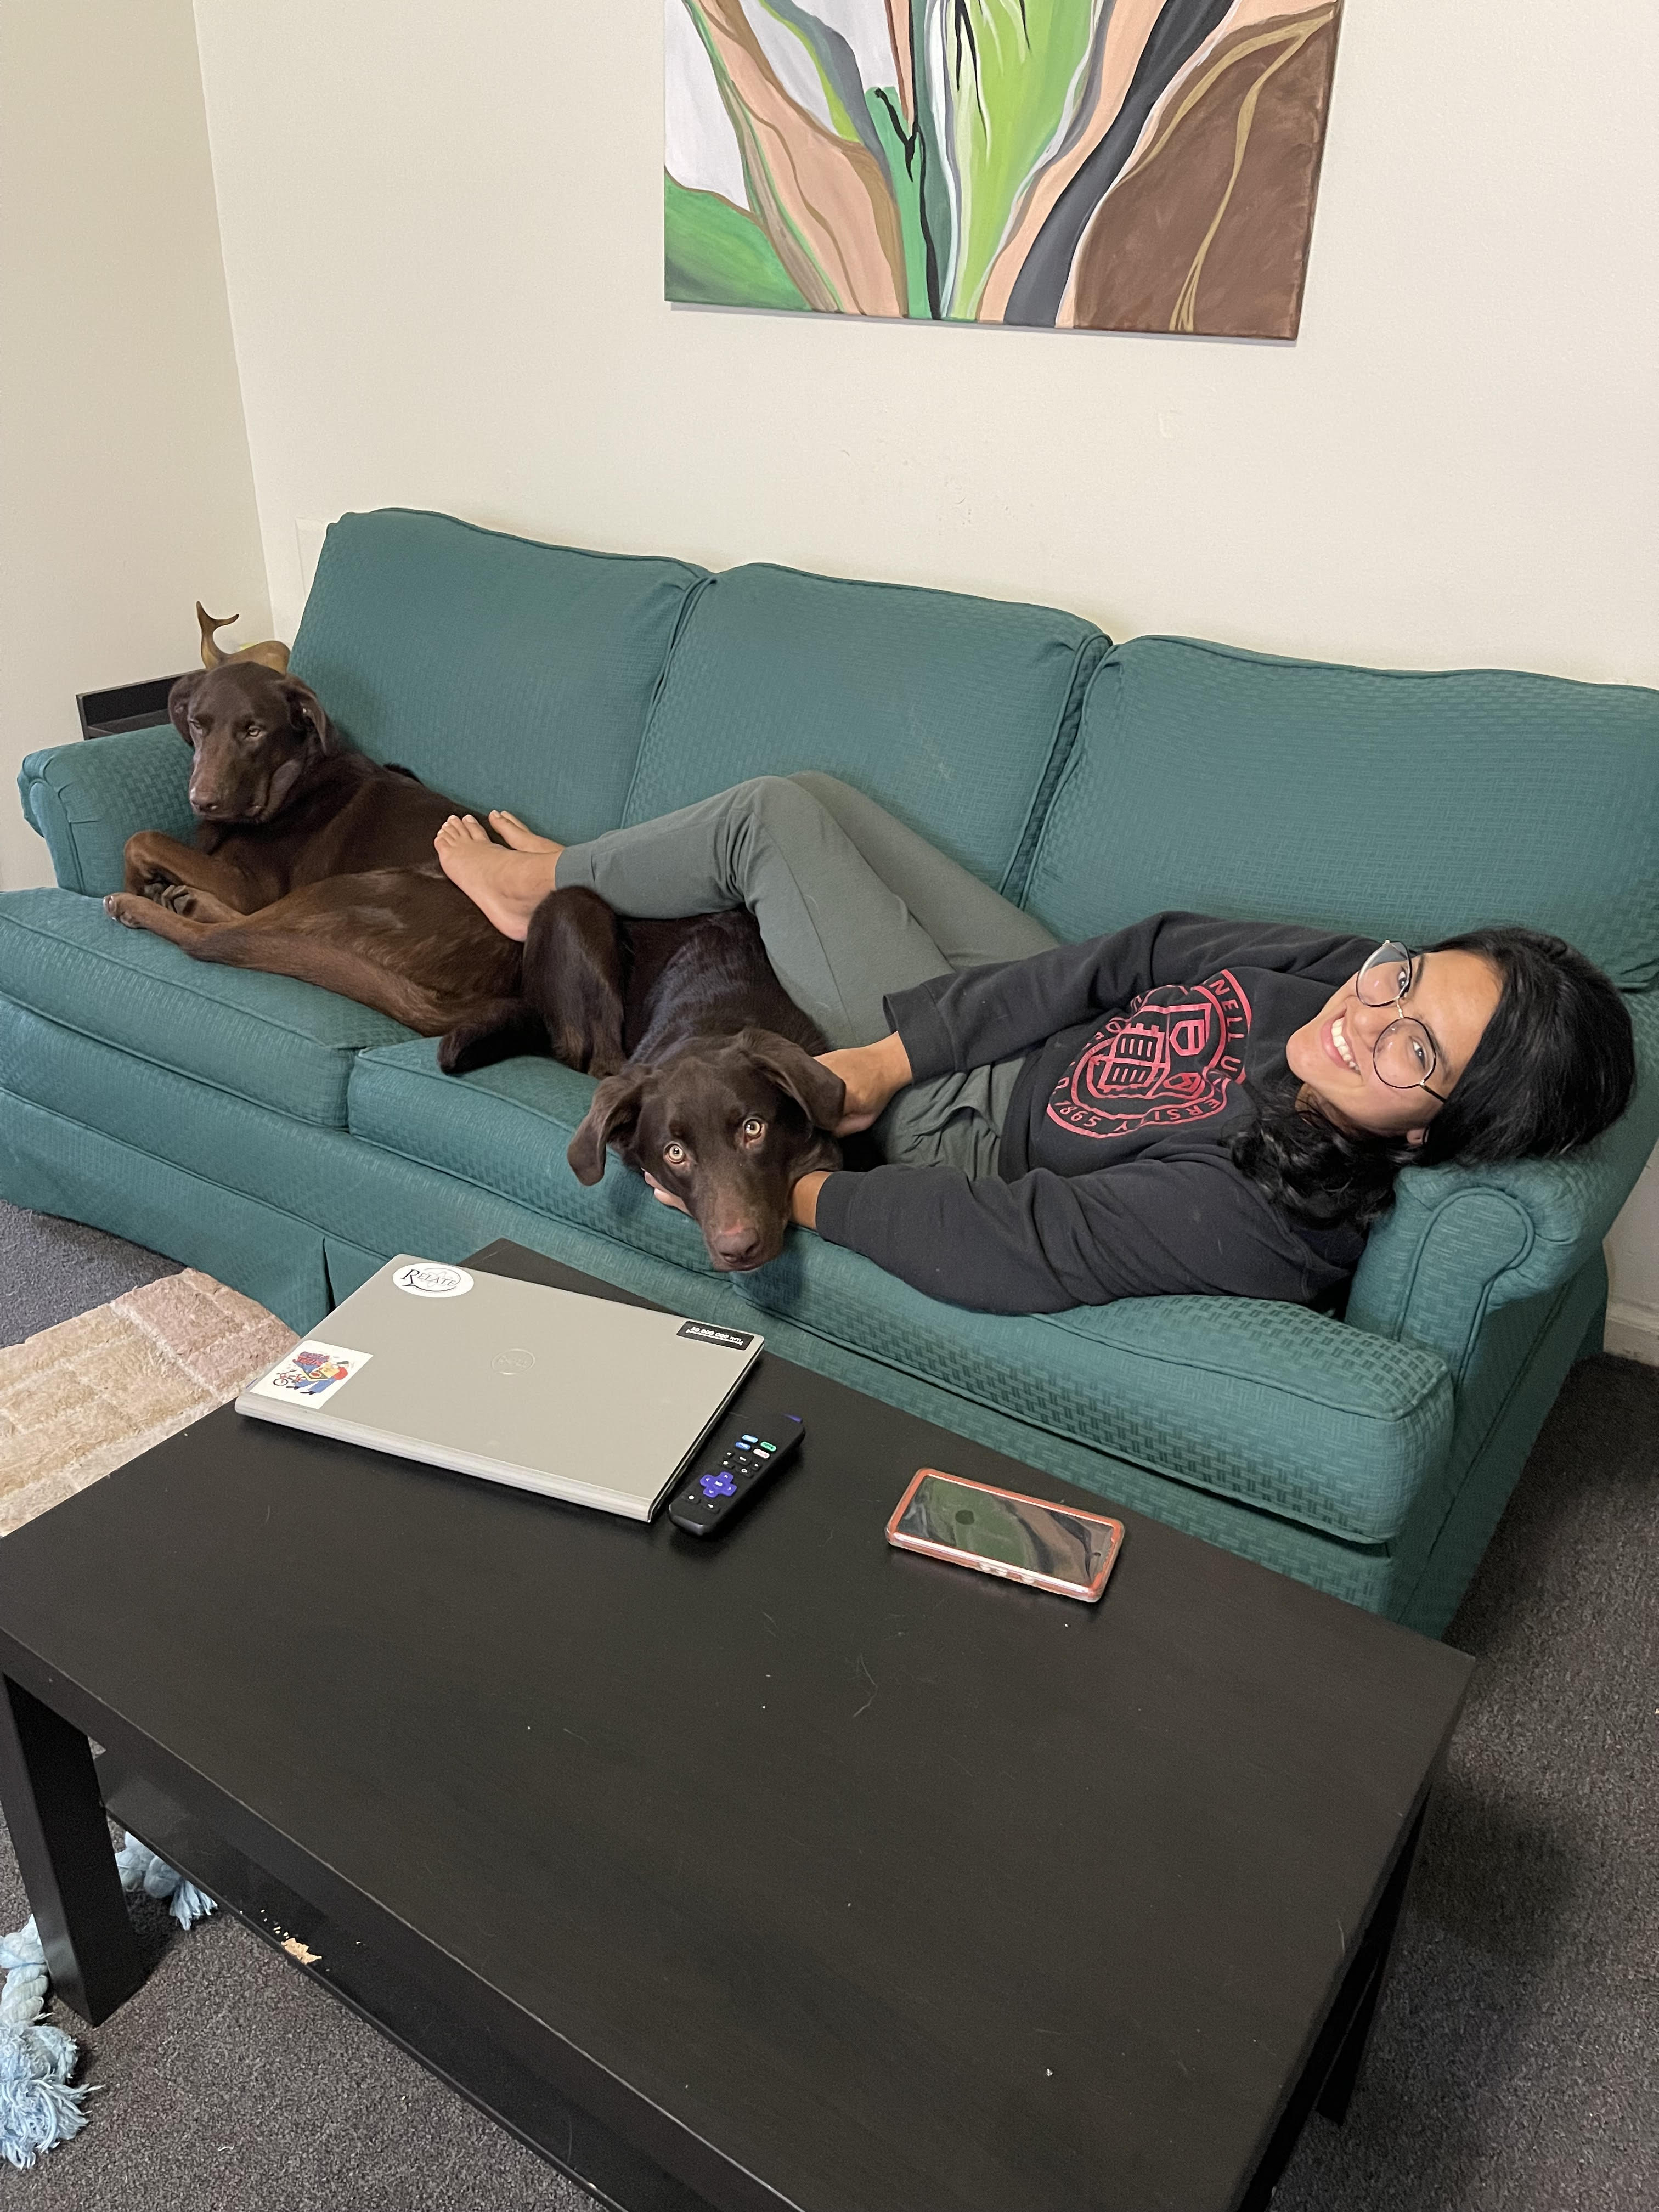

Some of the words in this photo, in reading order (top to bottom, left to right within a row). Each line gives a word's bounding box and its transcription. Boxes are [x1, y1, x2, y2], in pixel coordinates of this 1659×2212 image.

[1209, 978, 1245, 1043] NELL
[1054, 1100, 1102, 1127] 1865
[400, 1268, 458, 1287] RELATE
